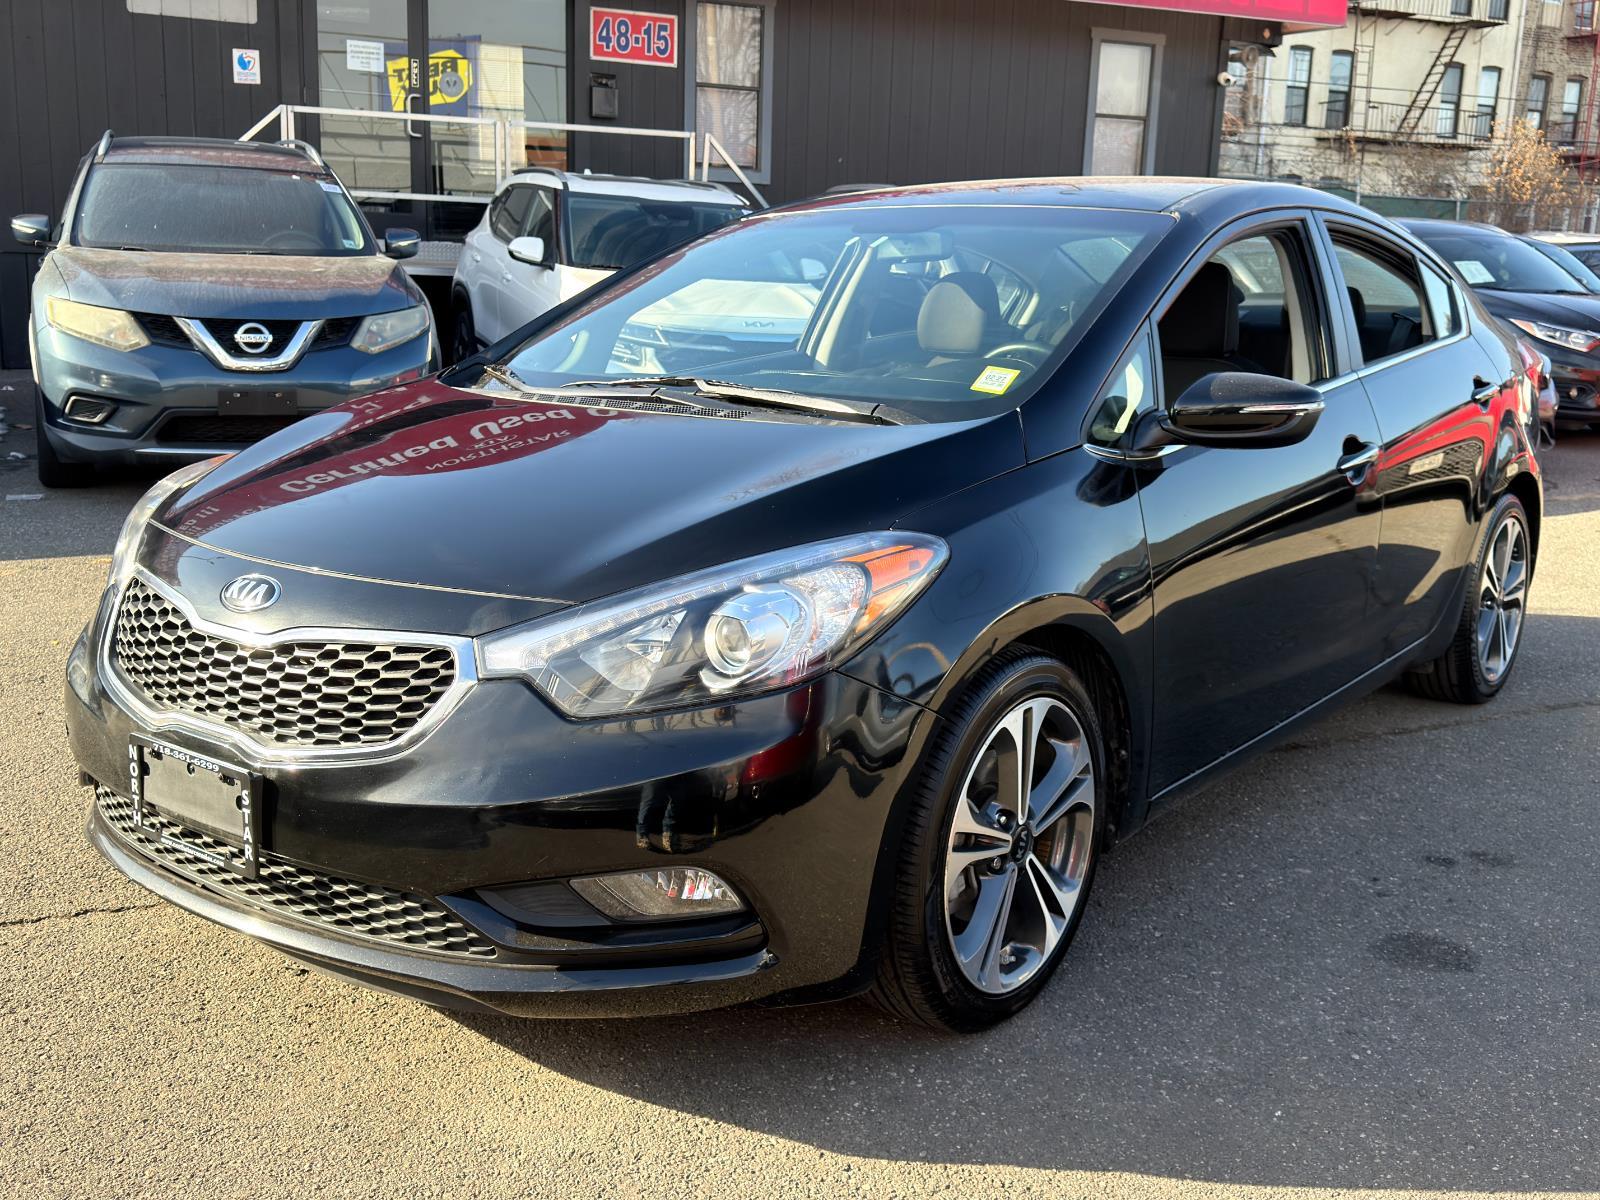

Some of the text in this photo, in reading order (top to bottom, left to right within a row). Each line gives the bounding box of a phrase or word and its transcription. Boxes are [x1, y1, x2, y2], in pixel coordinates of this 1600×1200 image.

[597, 17, 671, 58] 48-15
[225, 579, 268, 604] KIA
[129, 744, 142, 826] NORTH
[241, 789, 253, 861] STAR
